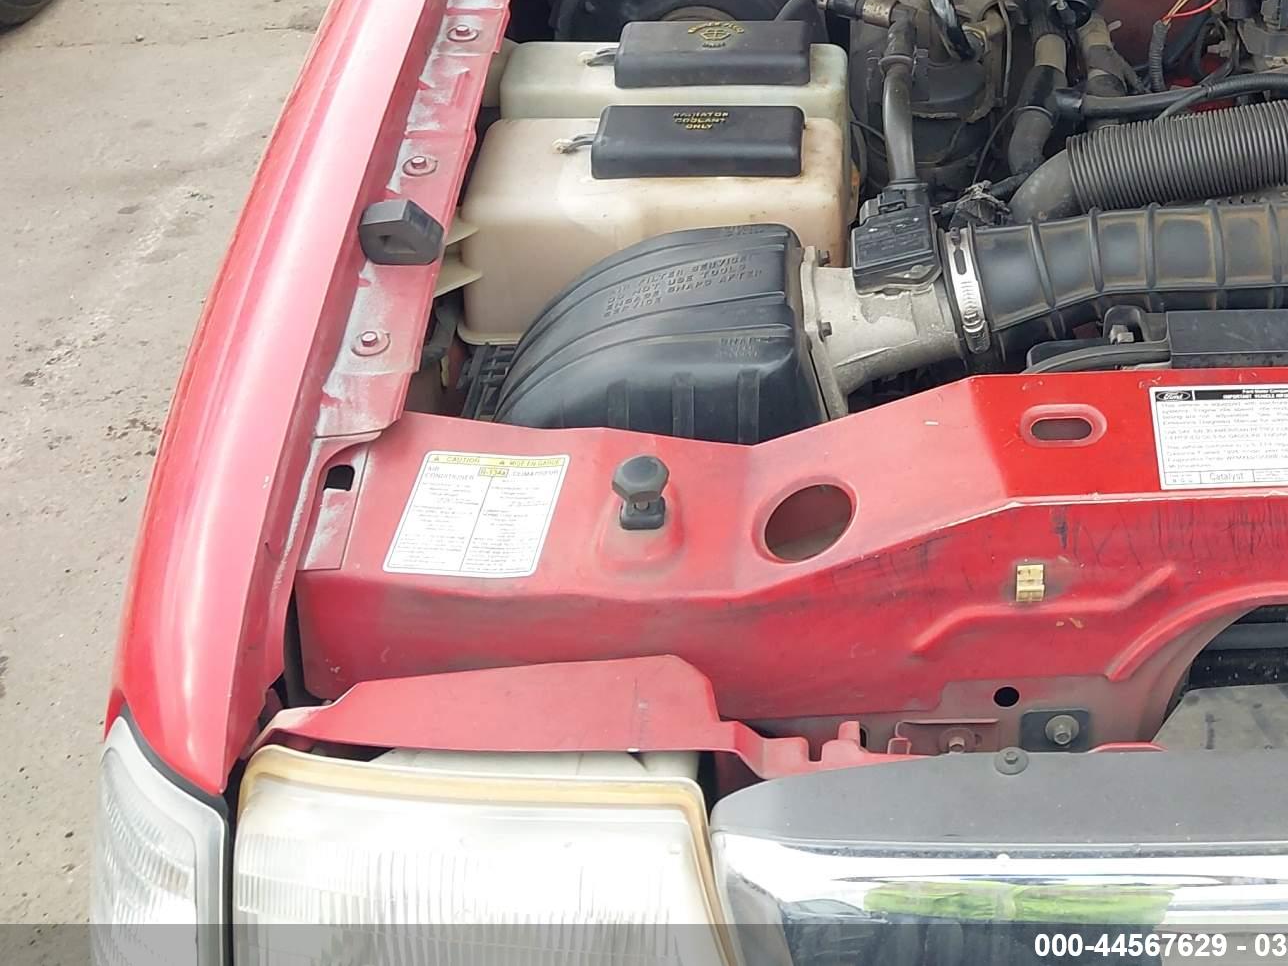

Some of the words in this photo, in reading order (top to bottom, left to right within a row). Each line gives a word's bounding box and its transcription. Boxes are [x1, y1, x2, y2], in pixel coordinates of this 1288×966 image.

[639, 269, 683, 284] FILTER
[691, 256, 749, 273] SERVICE
[668, 275, 694, 286] USE
[703, 265, 747, 279] TOOLS
[667, 279, 712, 294] SNAPS
[719, 268, 763, 284] AFTER
[446, 456, 480, 464] CAUTION
[1209, 472, 1244, 482] Catalyst
